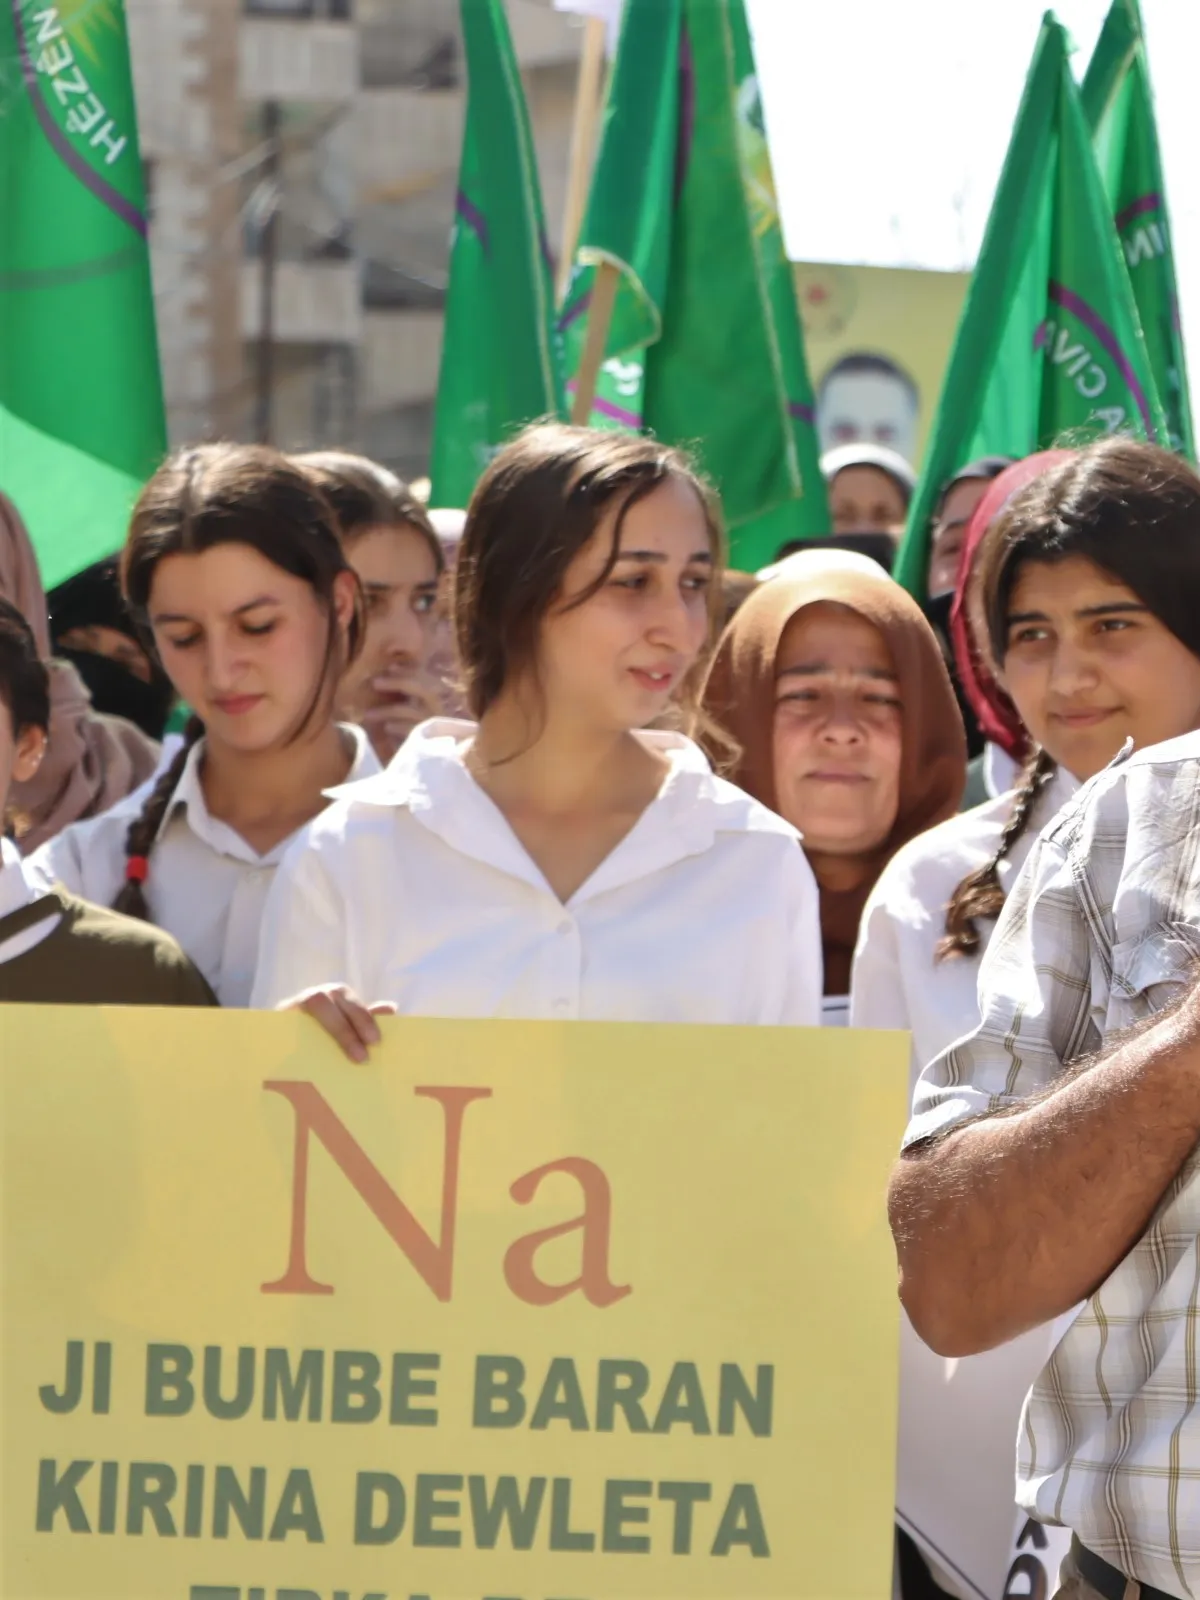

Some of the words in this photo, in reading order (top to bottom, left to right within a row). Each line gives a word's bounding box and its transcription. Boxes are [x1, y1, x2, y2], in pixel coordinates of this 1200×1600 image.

[259, 1080, 633, 1308] Na
[38, 1340, 112, 1415] JI
[144, 1343, 441, 1427] BUMBE
[472, 1354, 775, 1438] BARAN
[35, 1458, 325, 1544] KIRINA
[353, 1471, 770, 1558] DEWLETA
